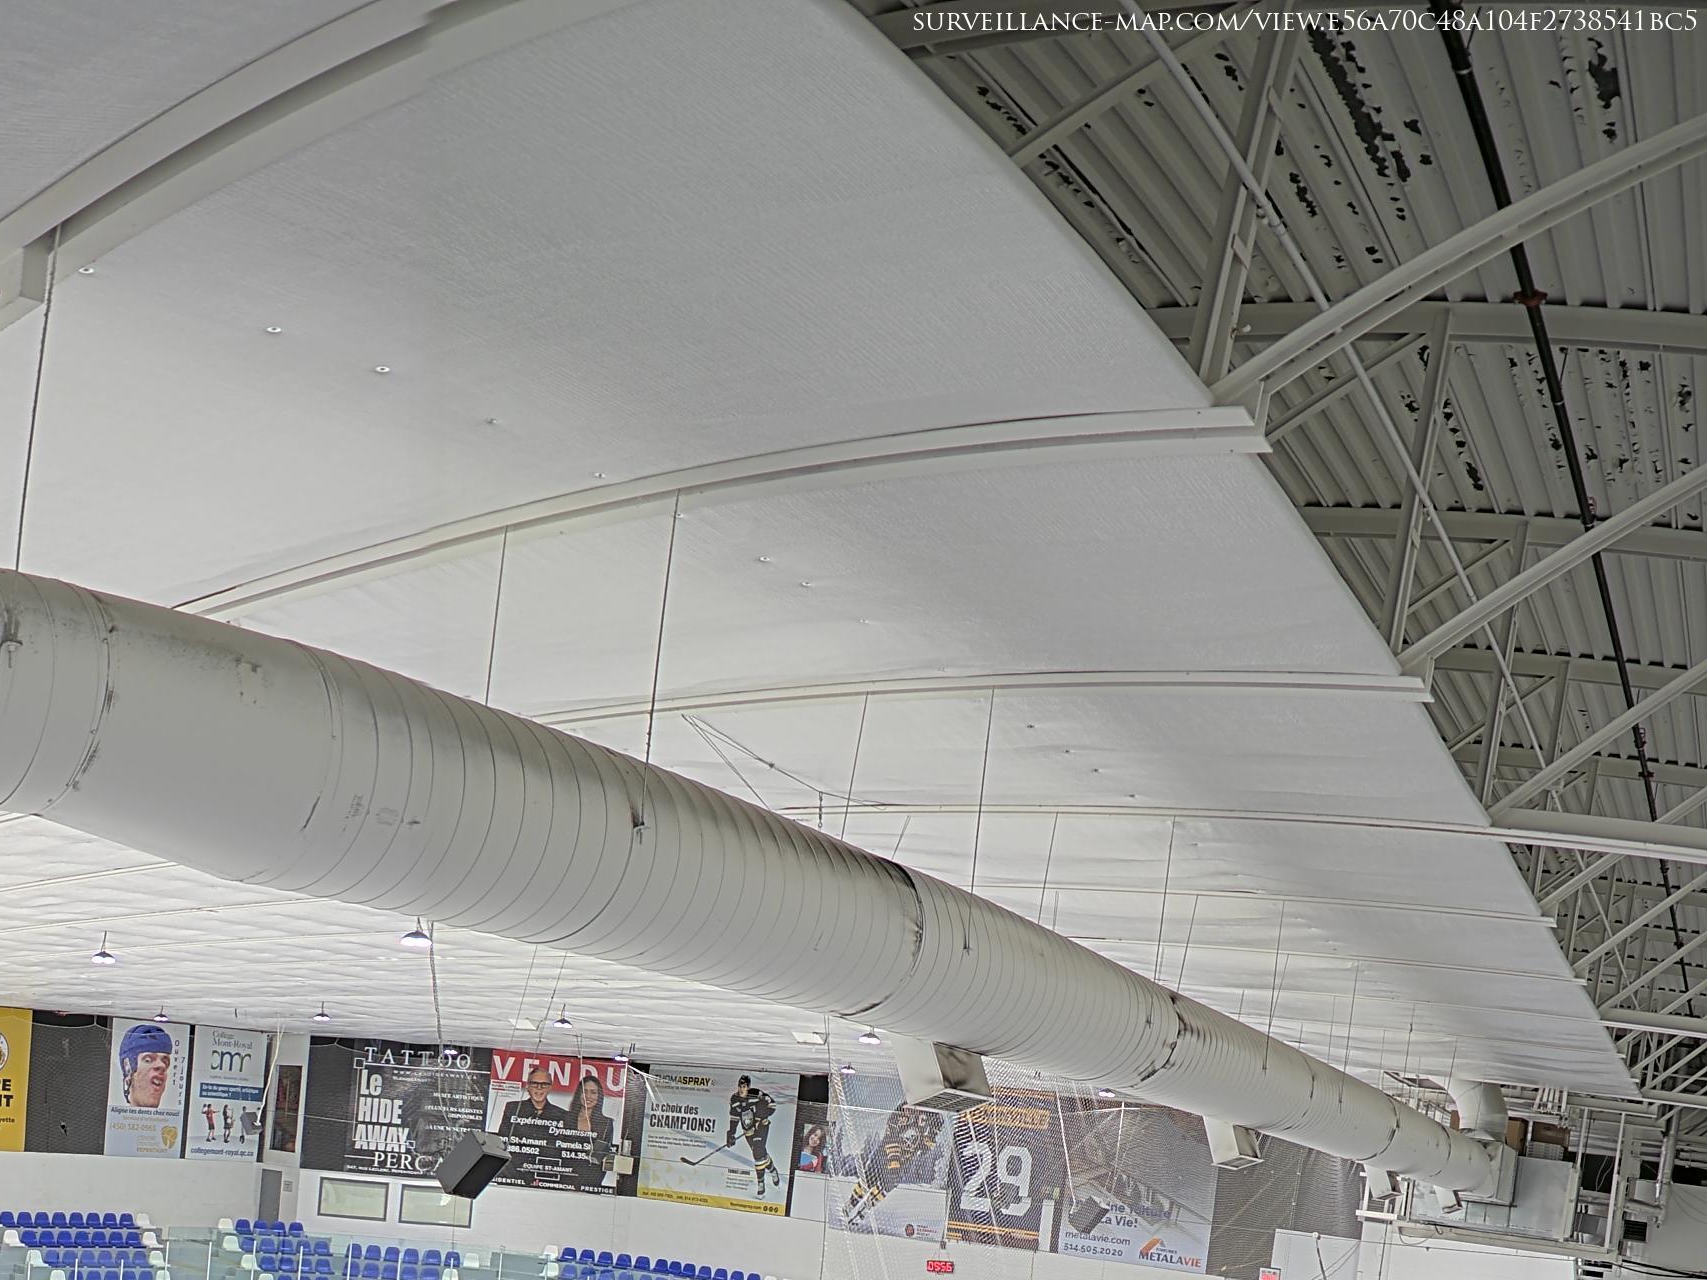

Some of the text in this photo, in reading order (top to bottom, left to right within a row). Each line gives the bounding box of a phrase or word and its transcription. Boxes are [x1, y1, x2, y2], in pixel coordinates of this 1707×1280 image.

[212, 1039, 252, 1051] Mont-Royal
[365, 1046, 472, 1070] TATTOO
[360, 1069, 382, 1096] Le
[111, 1106, 128, 1115] Aligne
[358, 1097, 403, 1124] HIDE
[661, 1103, 698, 1115] choix des
[511, 1115, 557, 1127] Expérience
[650, 1114, 716, 1133] CHAMPIONS!
[355, 1124, 410, 1153] AWAY
[549, 1127, 598, 1138] Dynamisme
[511, 1136, 547, 1146] St-Amant
[556, 1141, 582, 1149] Pamela
[191, 1146, 254, 1157] collegemont-royal.qc.ca
[545, 1165, 573, 1173] ST-AMANT
[959, 1141, 1033, 1217] 29
[539, 1182, 575, 1190] COMMERCIAL
[1065, 1230, 1131, 1246] metalavie.com
[1063, 1244, 1123, 1257] 514.505.2020
[1138, 1251, 1202, 1268] METALAVIE
